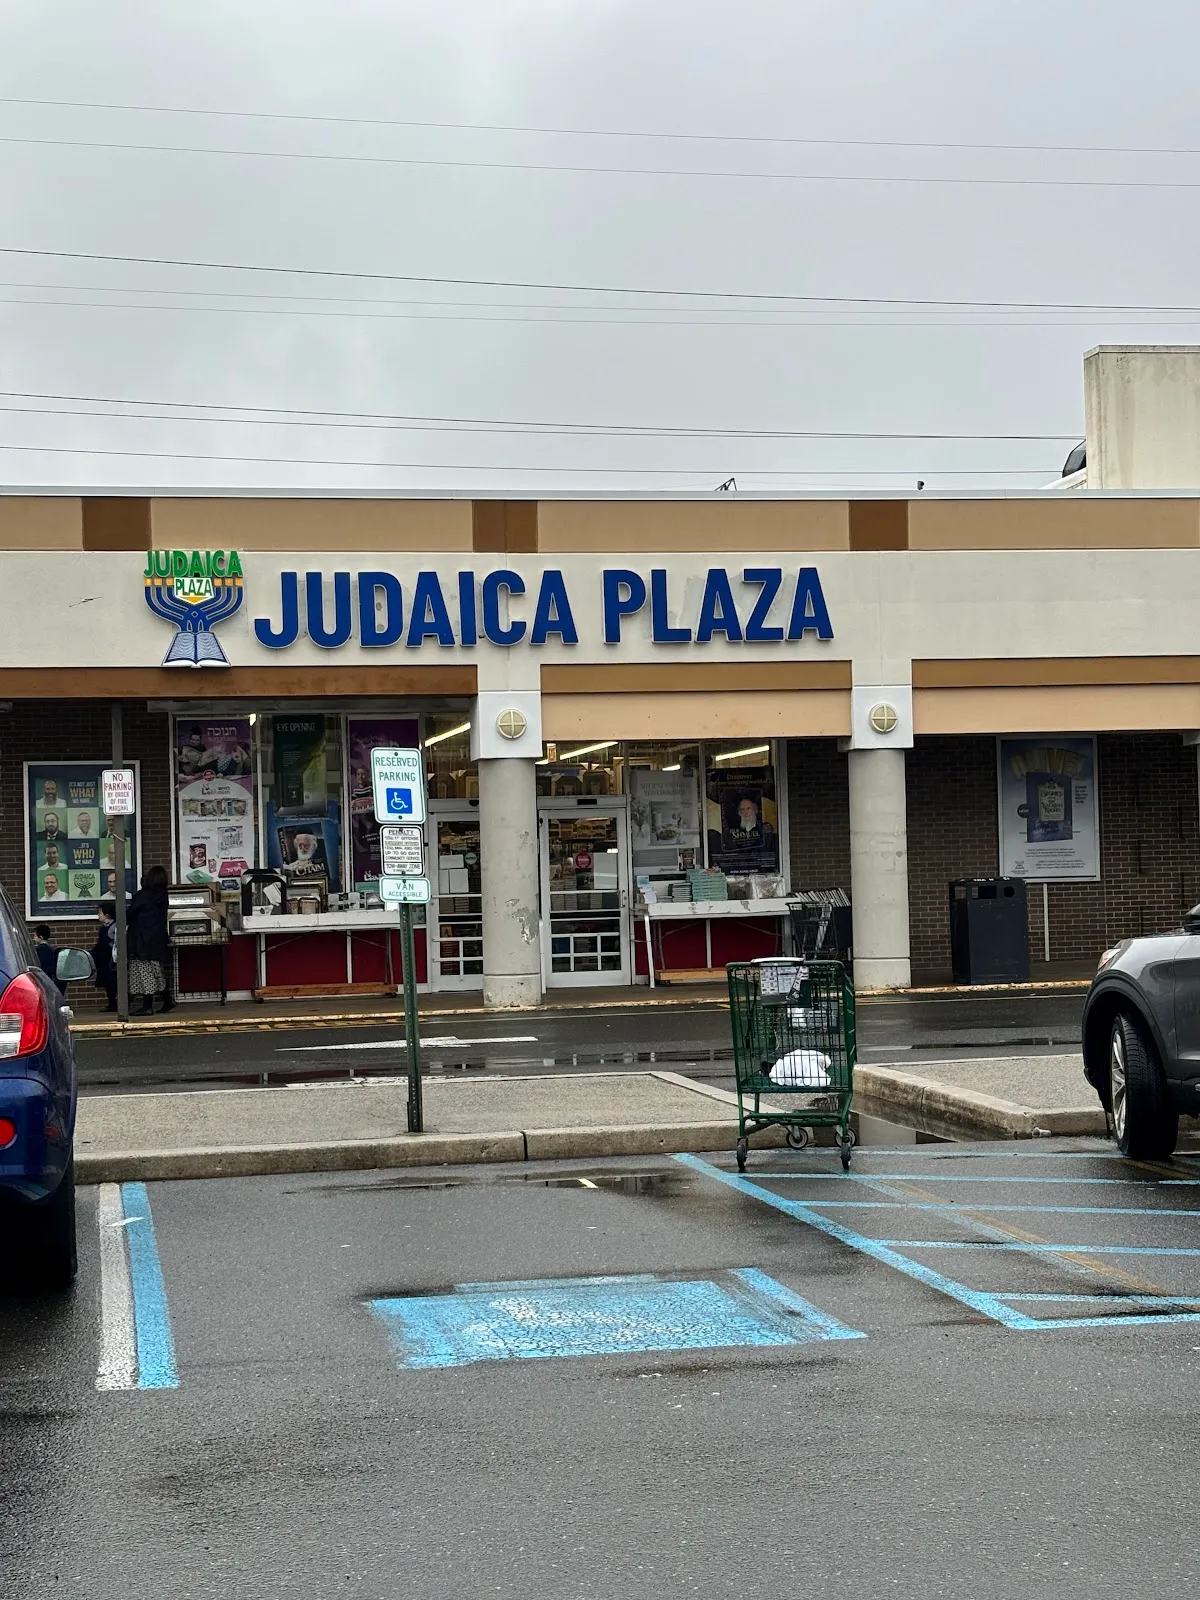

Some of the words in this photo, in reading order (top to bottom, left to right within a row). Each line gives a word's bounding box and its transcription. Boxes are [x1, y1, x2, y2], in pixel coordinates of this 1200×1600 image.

[143, 550, 243, 578] JUDAICA
[175, 578, 213, 597] PLAZA
[254, 570, 579, 649] JUDAICA
[602, 567, 834, 645] PLAZA
[206, 727, 237, 736] חנוכה
[276, 722, 290, 732] EYE
[375, 756, 418, 767] RESERVED
[112, 772, 124, 782] NO
[379, 771, 416, 782] PARKING
[104, 782, 132, 791] PARKING
[69, 787, 96, 798] WHAT
[73, 848, 95, 859] WHO
[396, 882, 414, 890] VAN
